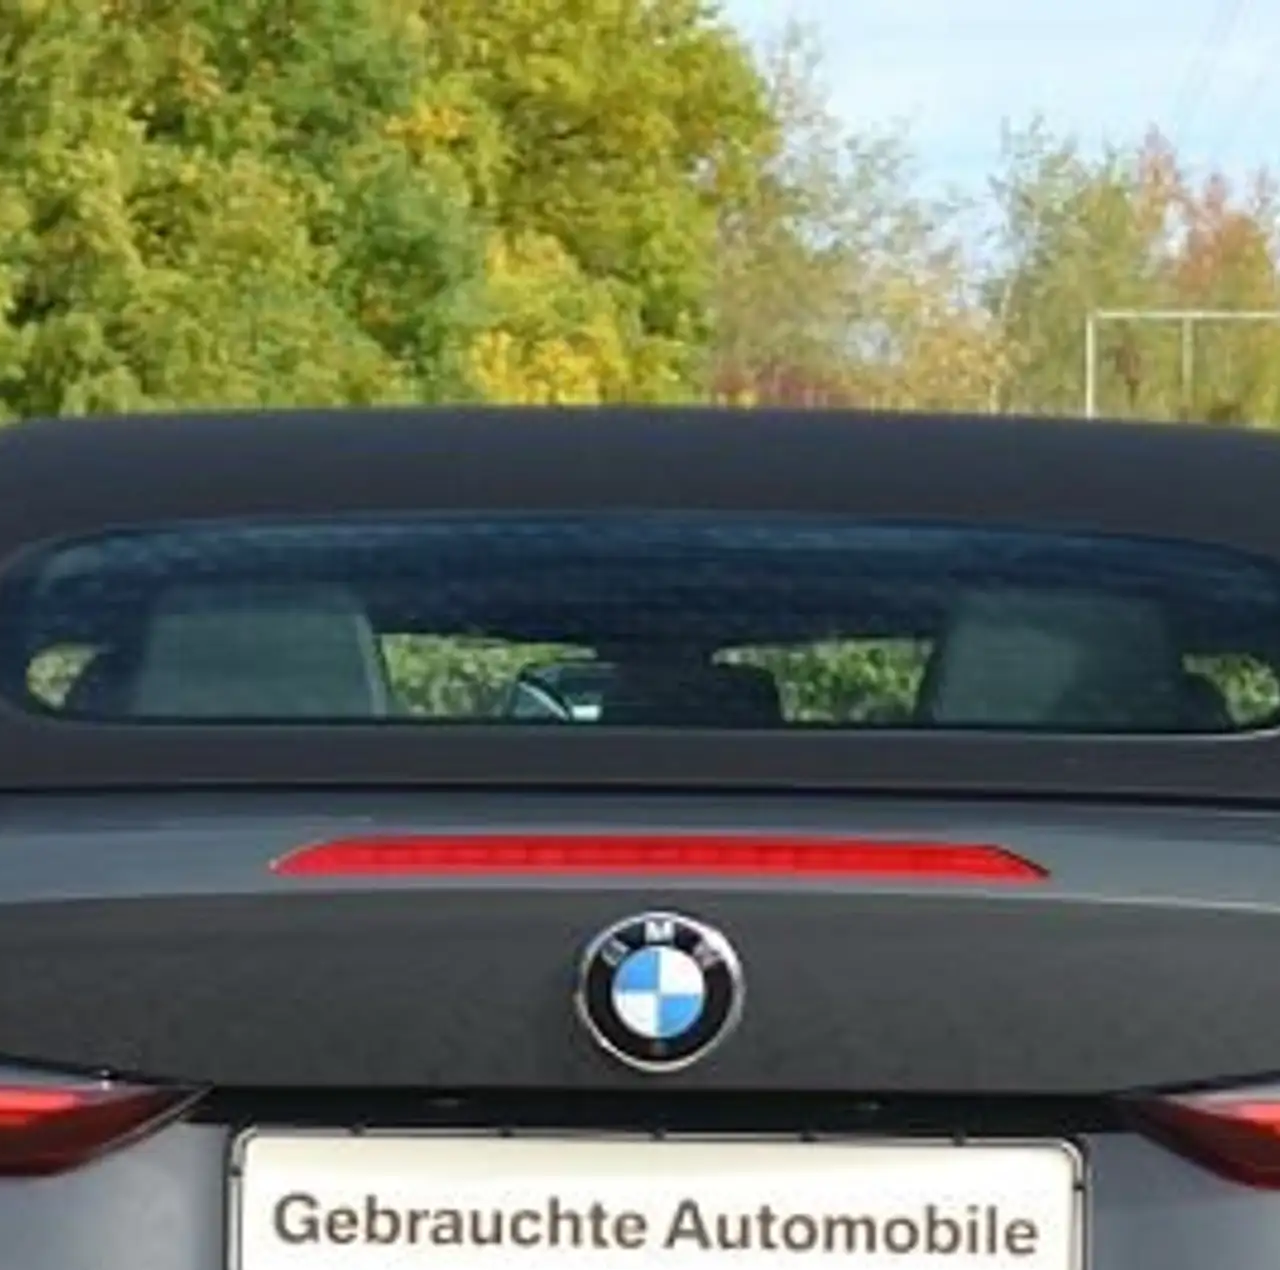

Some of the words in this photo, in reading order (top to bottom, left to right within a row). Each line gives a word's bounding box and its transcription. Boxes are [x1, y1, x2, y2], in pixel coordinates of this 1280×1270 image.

[600, 920, 723, 968] BMW
[273, 1191, 648, 1249] Gebrauchte
[663, 1198, 1040, 1256] Automobile
